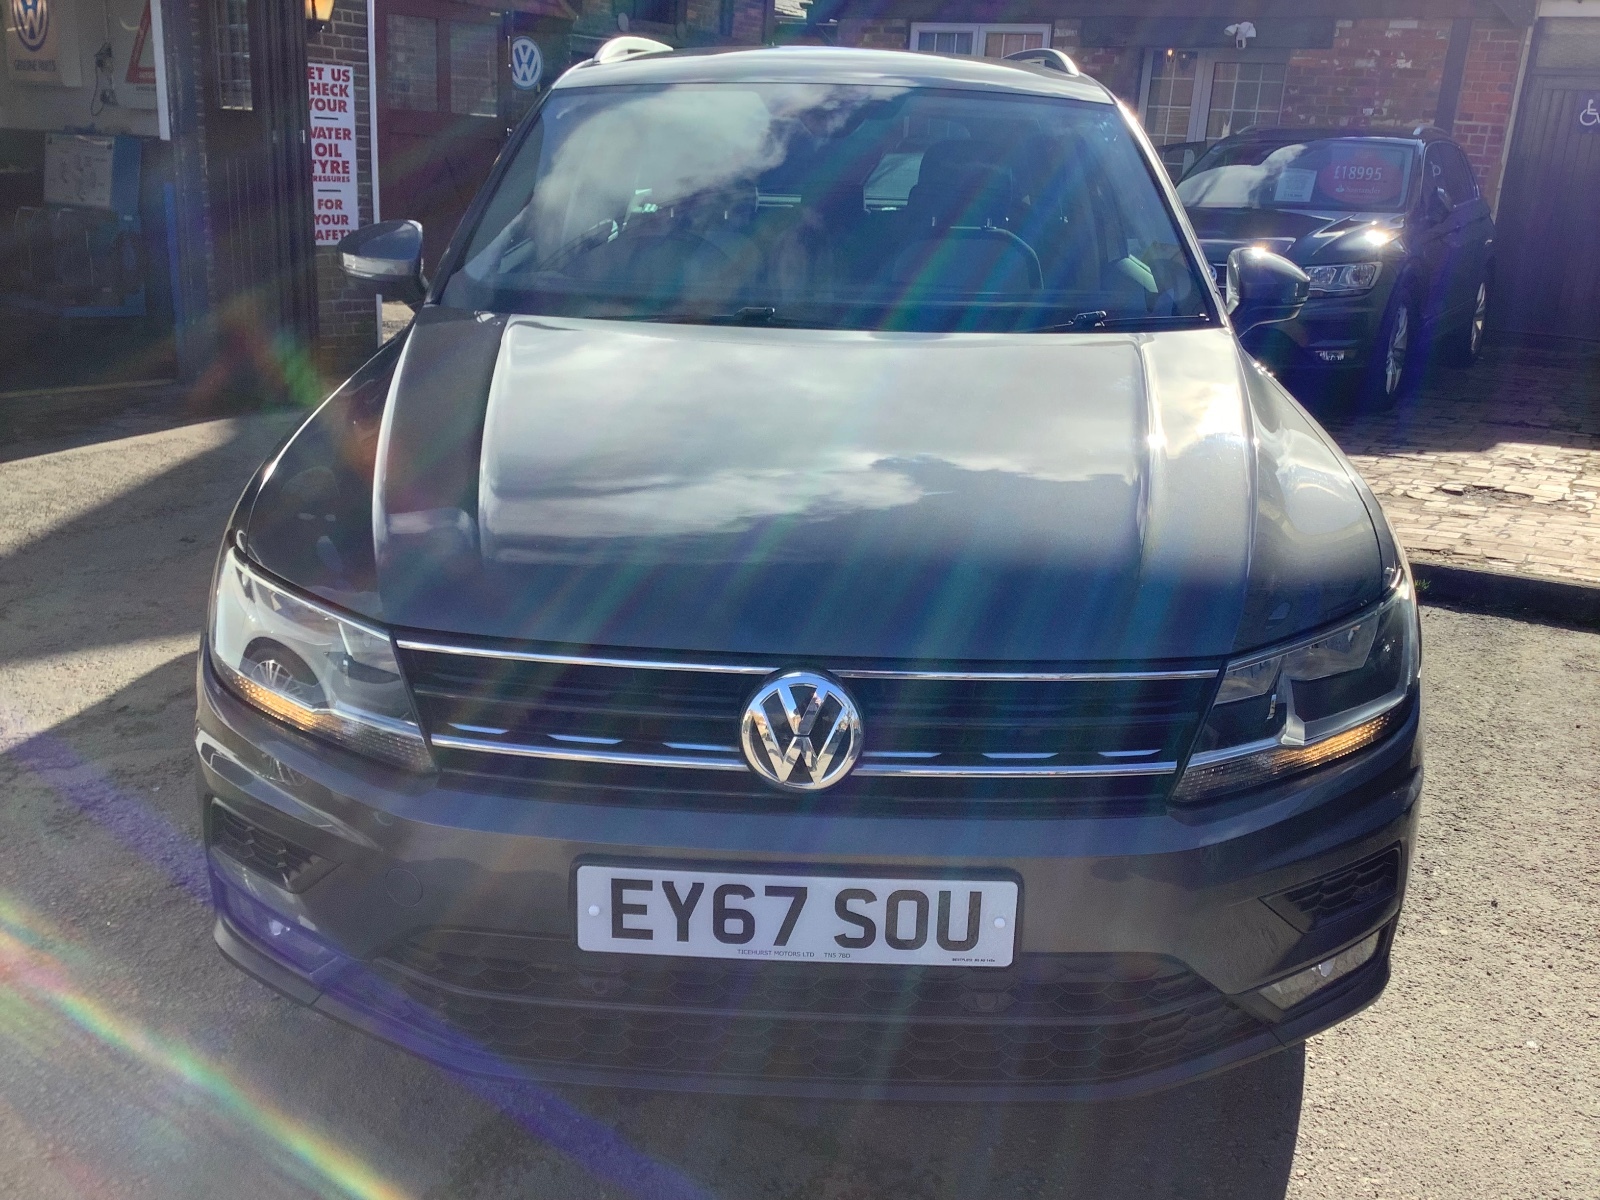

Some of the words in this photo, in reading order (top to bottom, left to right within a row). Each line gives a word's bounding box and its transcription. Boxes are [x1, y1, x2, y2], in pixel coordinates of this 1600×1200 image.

[307, 67, 324, 80] ET
[331, 68, 350, 82] US
[310, 82, 349, 98] HECK
[315, 142, 342, 158] OIL
[313, 175, 350, 183] RESSURES
[1333, 165, 1382, 180] £18995
[317, 199, 343, 210] FOR
[314, 213, 349, 225] YOUR
[610, 877, 808, 947] EY67
[834, 887, 983, 952] SOU
[773, 950, 801, 958] MOTORS
